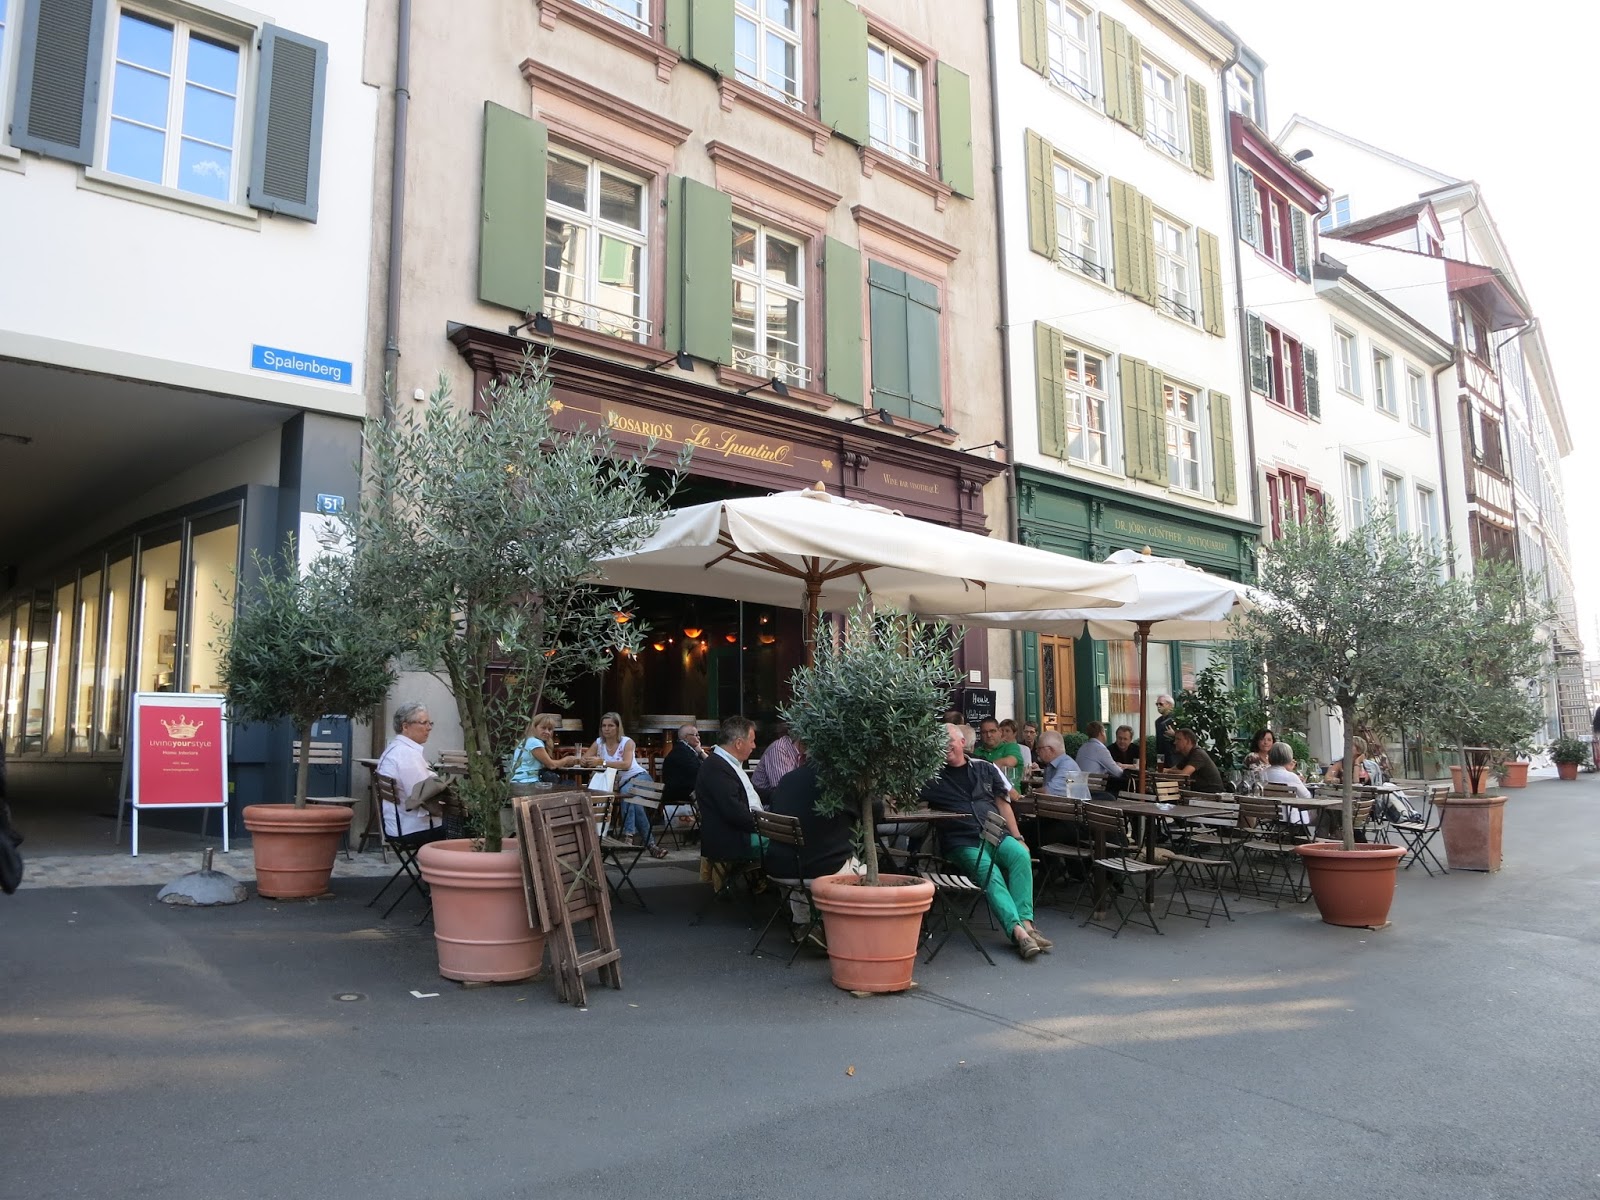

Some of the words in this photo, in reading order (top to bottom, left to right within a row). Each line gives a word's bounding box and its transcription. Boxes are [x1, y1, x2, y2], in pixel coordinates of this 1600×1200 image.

[263, 350, 342, 381] Spalenberg
[324, 497, 337, 510] 51
[1115, 519, 1127, 531] DR.
[1128, 521, 1147, 535] JÖRN
[1148, 525, 1182, 543] GÜNTHER
[1187, 535, 1229, 553] ANTIQUARIAT
